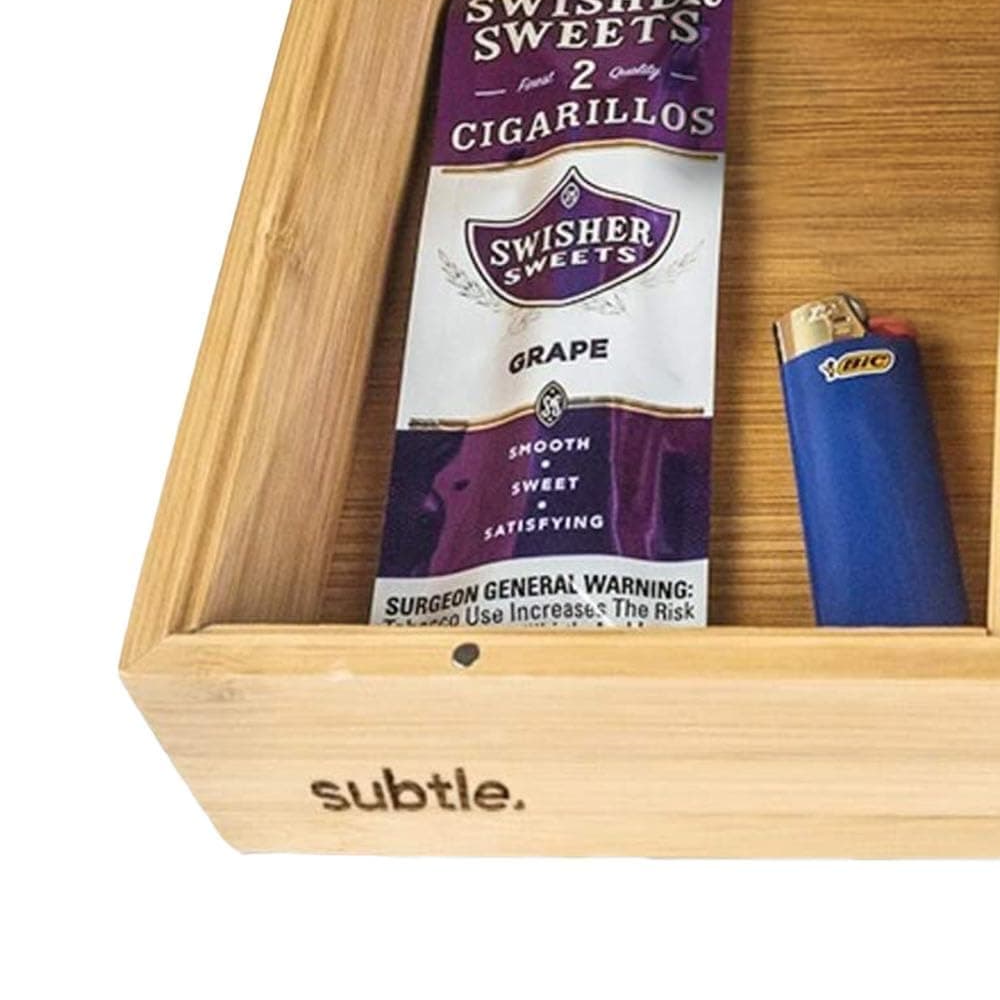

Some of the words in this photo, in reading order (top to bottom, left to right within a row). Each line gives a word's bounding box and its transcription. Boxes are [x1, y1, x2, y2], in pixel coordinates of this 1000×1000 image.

[474, 9, 702, 62] SWEETS
[570, 59, 596, 90] 2
[609, 63, 660, 81] Quality
[451, 97, 716, 151] CIGARILLOS
[489, 215, 654, 266] SWISHER
[503, 246, 638, 286] SWEETS
[508, 338, 610, 375] GRAPE
[843, 355, 888, 371] BIC
[508, 436, 590, 460] SMOOTH
[511, 476, 580, 496] SWEET
[483, 515, 604, 542] SATISFYING
[385, 584, 479, 616] SURGEON
[483, 574, 578, 601] GENERAL
[584, 574, 694, 600] WARNING:
[465, 605, 503, 626] Use
[510, 602, 607, 623] Increases
[612, 598, 649, 618] The
[654, 601, 695, 622] Risk
[311, 767, 525, 811] subtle.
